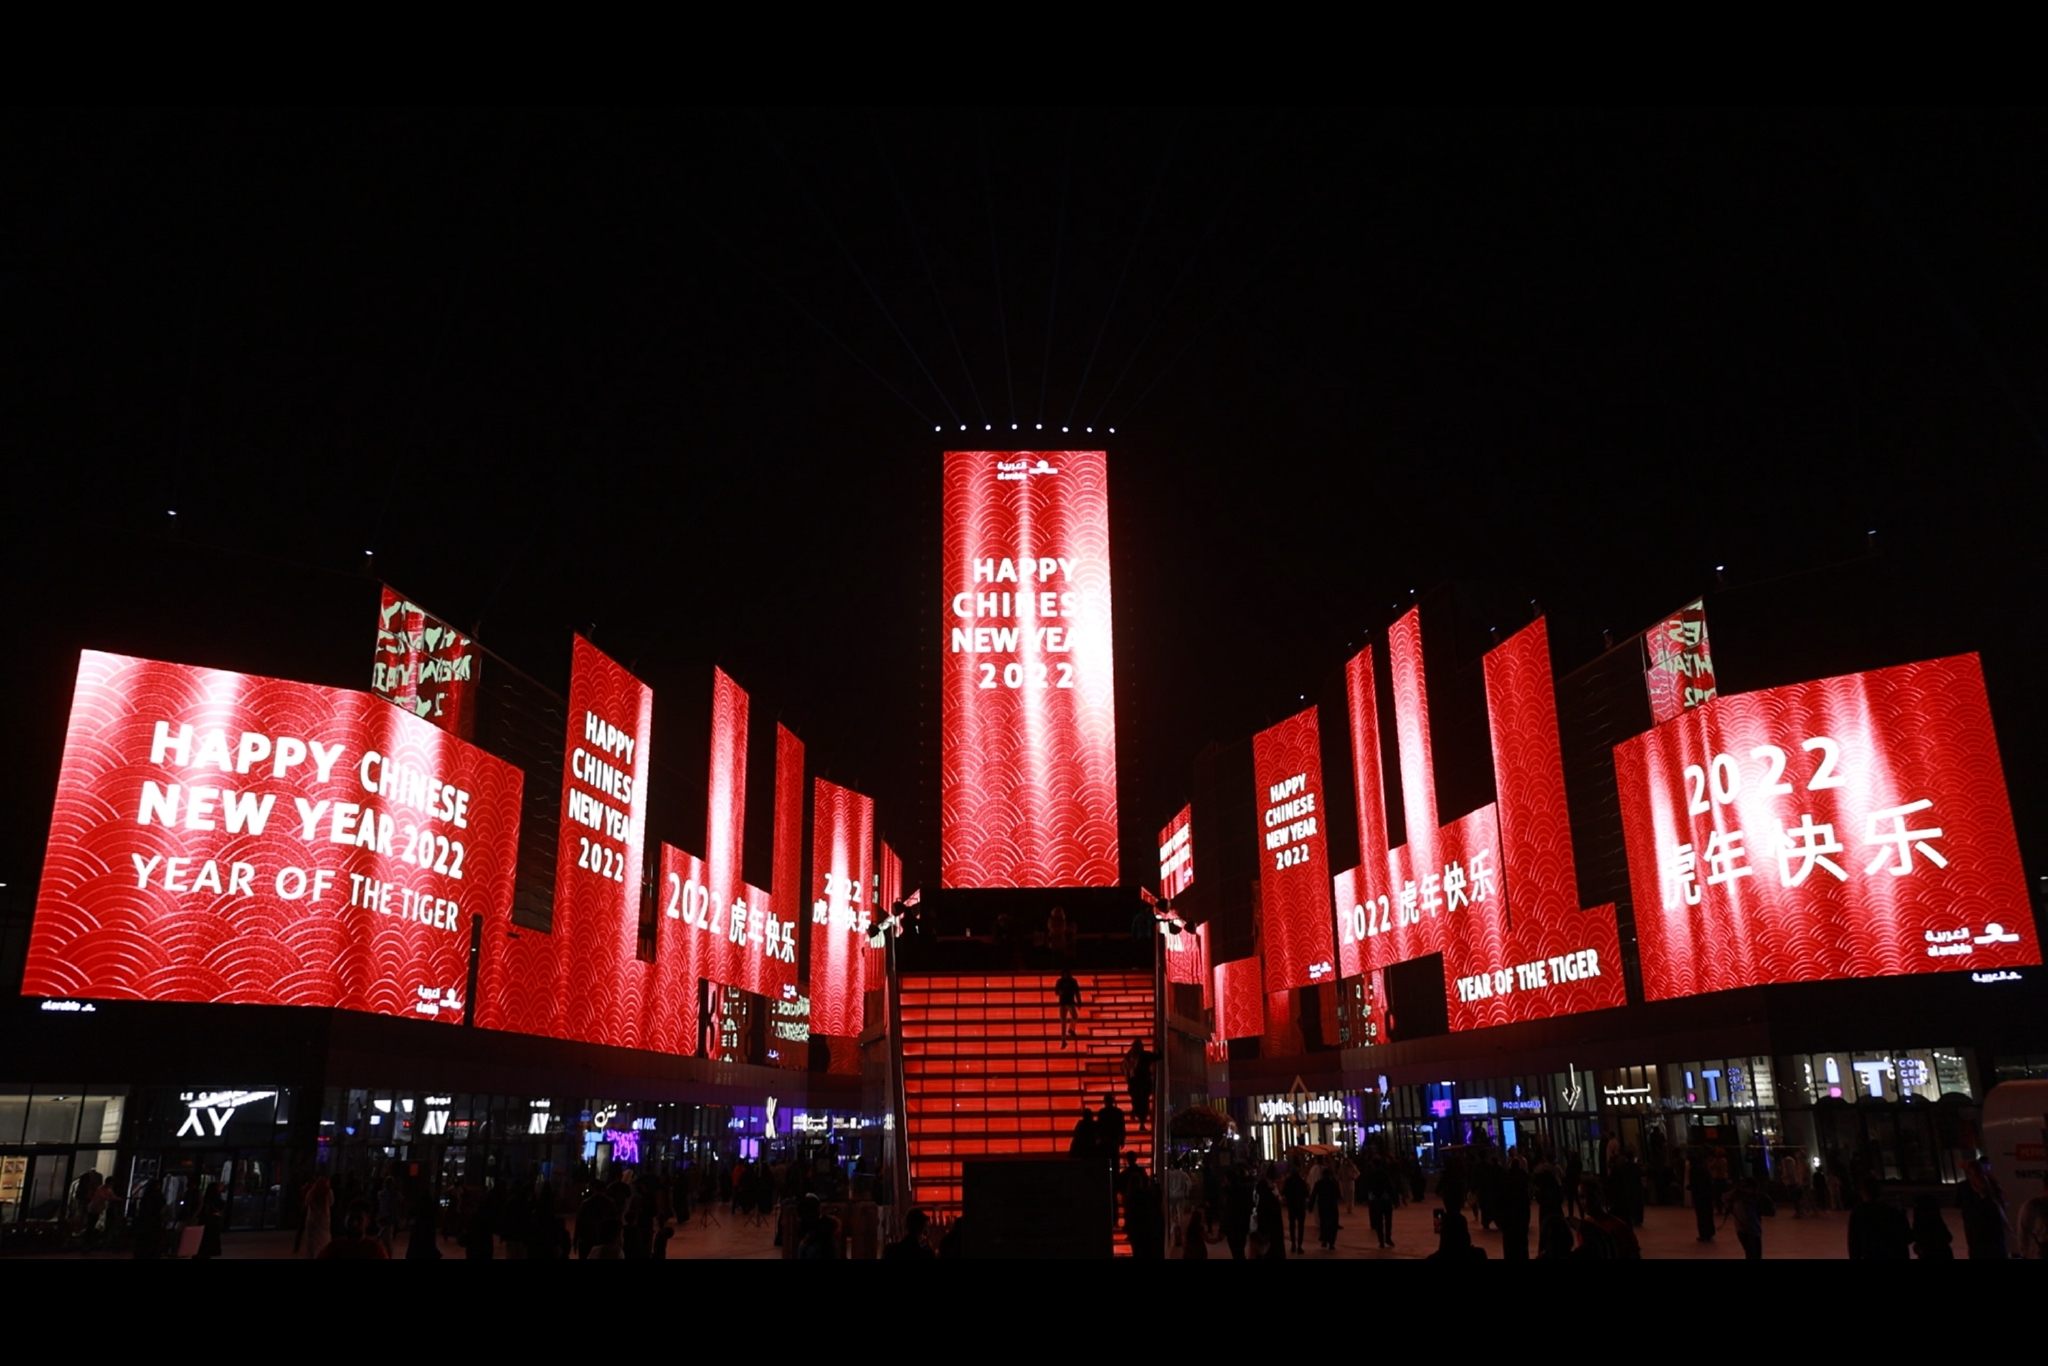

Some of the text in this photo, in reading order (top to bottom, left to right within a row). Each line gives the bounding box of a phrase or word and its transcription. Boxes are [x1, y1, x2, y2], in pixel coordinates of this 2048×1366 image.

[973, 557, 1079, 582] HAPPY
[953, 592, 1097, 617] CHINES
[952, 627, 1020, 653] NEW
[979, 662, 1074, 689] 2022
[585, 710, 635, 765] HAPPY
[150, 720, 470, 829] HAPPY CHINESE
[573, 748, 641, 808] CHINES
[1270, 773, 1306, 803] HAPPY
[1684, 736, 1847, 816] 2022
[137, 781, 465, 880] NEW YEAR 2022
[569, 788, 640, 850] NEW YEA
[1265, 793, 1315, 827] CHINESE
[1266, 816, 1317, 850] NEW YEAR
[578, 837, 624, 882] 2022
[1276, 844, 1310, 870] 2022
[1662, 798, 1947, 911] 虎年快乐
[131, 853, 458, 932] YEAR OF THE TIGER
[824, 873, 862, 903] 222
[1342, 848, 1496, 944] 2022 虎年快乐
[666, 872, 795, 963] 2022 虎年快乐
[1457, 948, 1601, 1002] YEAR OF THE TIGER
